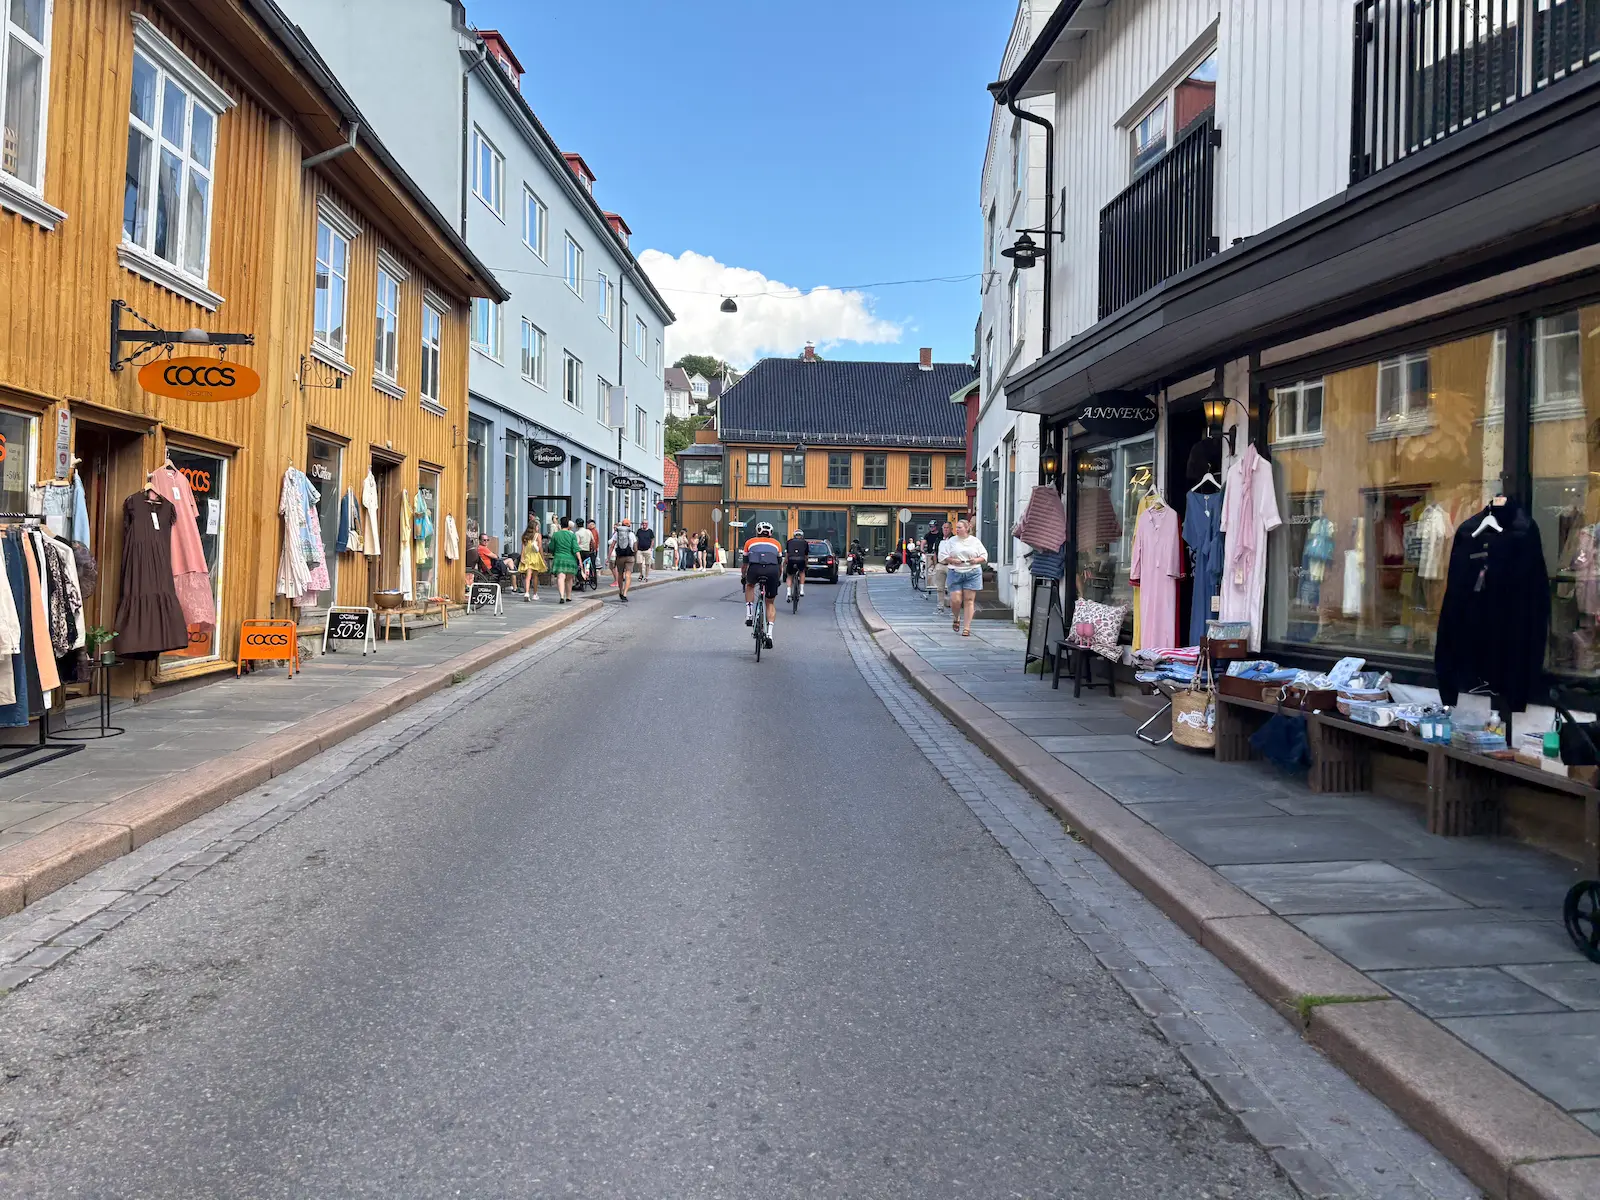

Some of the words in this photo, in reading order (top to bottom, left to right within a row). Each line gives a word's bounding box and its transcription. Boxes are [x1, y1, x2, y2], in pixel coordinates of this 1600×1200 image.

[1078, 406, 1156, 421] ANNEK'S
[470, 594, 495, 604] -50%
[331, 624, 364, 638] -50%
